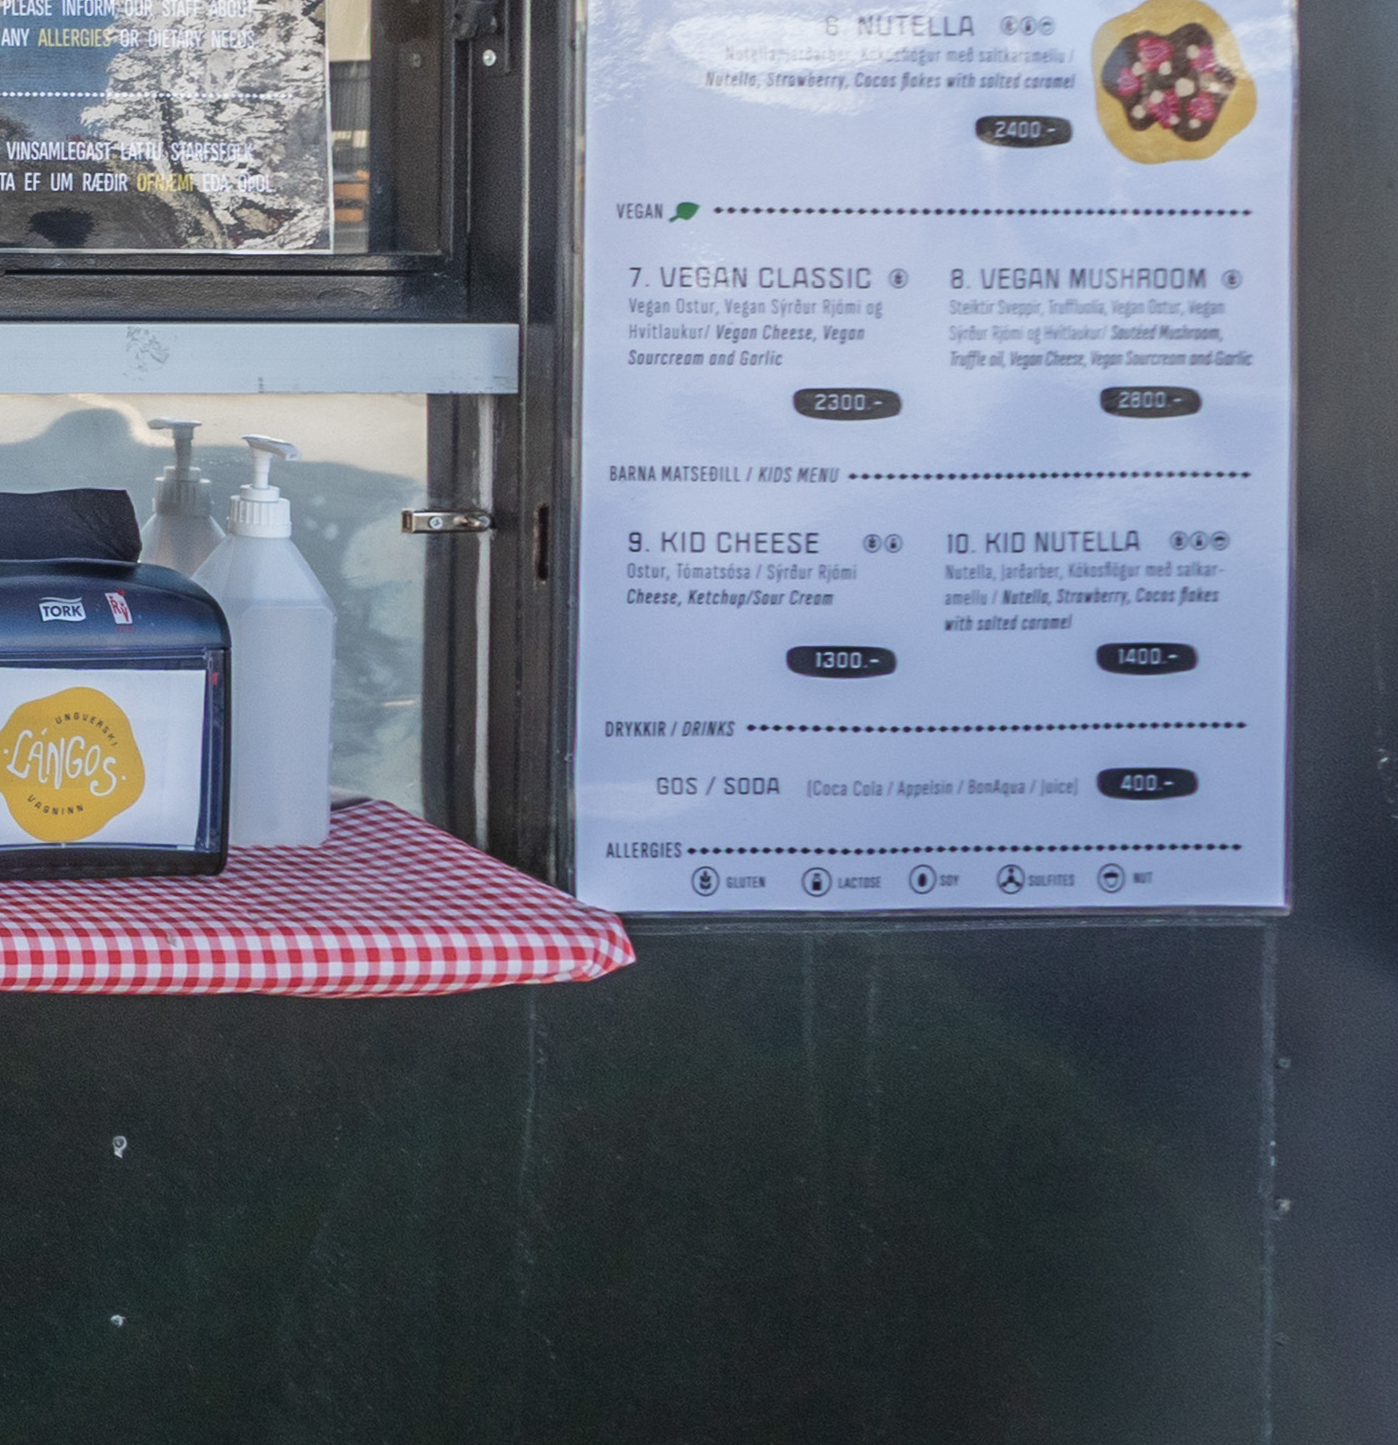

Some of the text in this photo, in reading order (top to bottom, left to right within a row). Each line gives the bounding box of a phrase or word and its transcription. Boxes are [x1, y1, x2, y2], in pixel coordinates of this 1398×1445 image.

[858, 16, 975, 38] NUTELLA
[1, 29, 30, 47] ANY
[38, 29, 111, 48] ALLERGIES
[120, 30, 139, 48] OR
[148, 30, 202, 48] DIETARY
[5, 140, 111, 161] VINSAMLEGAST
[24, 172, 41, 192] EF
[51, 172, 73, 192] UM
[82, 172, 128, 192] RÆÐIR
[616, 203, 663, 220] VEGAN
[629, 267, 872, 289] 7. VEGAN CLASSIC
[950, 268, 1206, 289] 8. VEGAN MUSHROOM
[629, 298, 670, 318] Vegan
[676, 298, 719, 317] Ostur,
[725, 299, 766, 319] Vegan
[866, 303, 883, 319] og
[716, 325, 757, 343] Vegan
[762, 325, 817, 342] Cheese,
[823, 325, 865, 344] Vegan
[628, 350, 783, 366] Sourcream and Garlic
[609, 465, 656, 482] BARNA
[661, 466, 741, 483] MATSEÐILL
[758, 466, 793, 483] KIDS
[797, 467, 840, 483] MENU
[628, 531, 821, 554] 9. KID CHEESE
[947, 529, 1142, 554] 10. KID NUTELLA
[627, 589, 682, 606] Cheese,
[789, 590, 834, 605] Cream
[43, 605, 83, 617] TORK
[605, 721, 666, 737] DRYKKIR
[681, 721, 735, 737] DRINKS
[657, 777, 698, 795] GOS
[724, 777, 781, 795] SODA
[27, 794, 84, 815] VAGNINN
[606, 842, 682, 859] ALLERGIES
[726, 876, 766, 889] GLUTEN
[838, 876, 882, 889] LACTOSE
[1133, 871, 1153, 884] NUT
